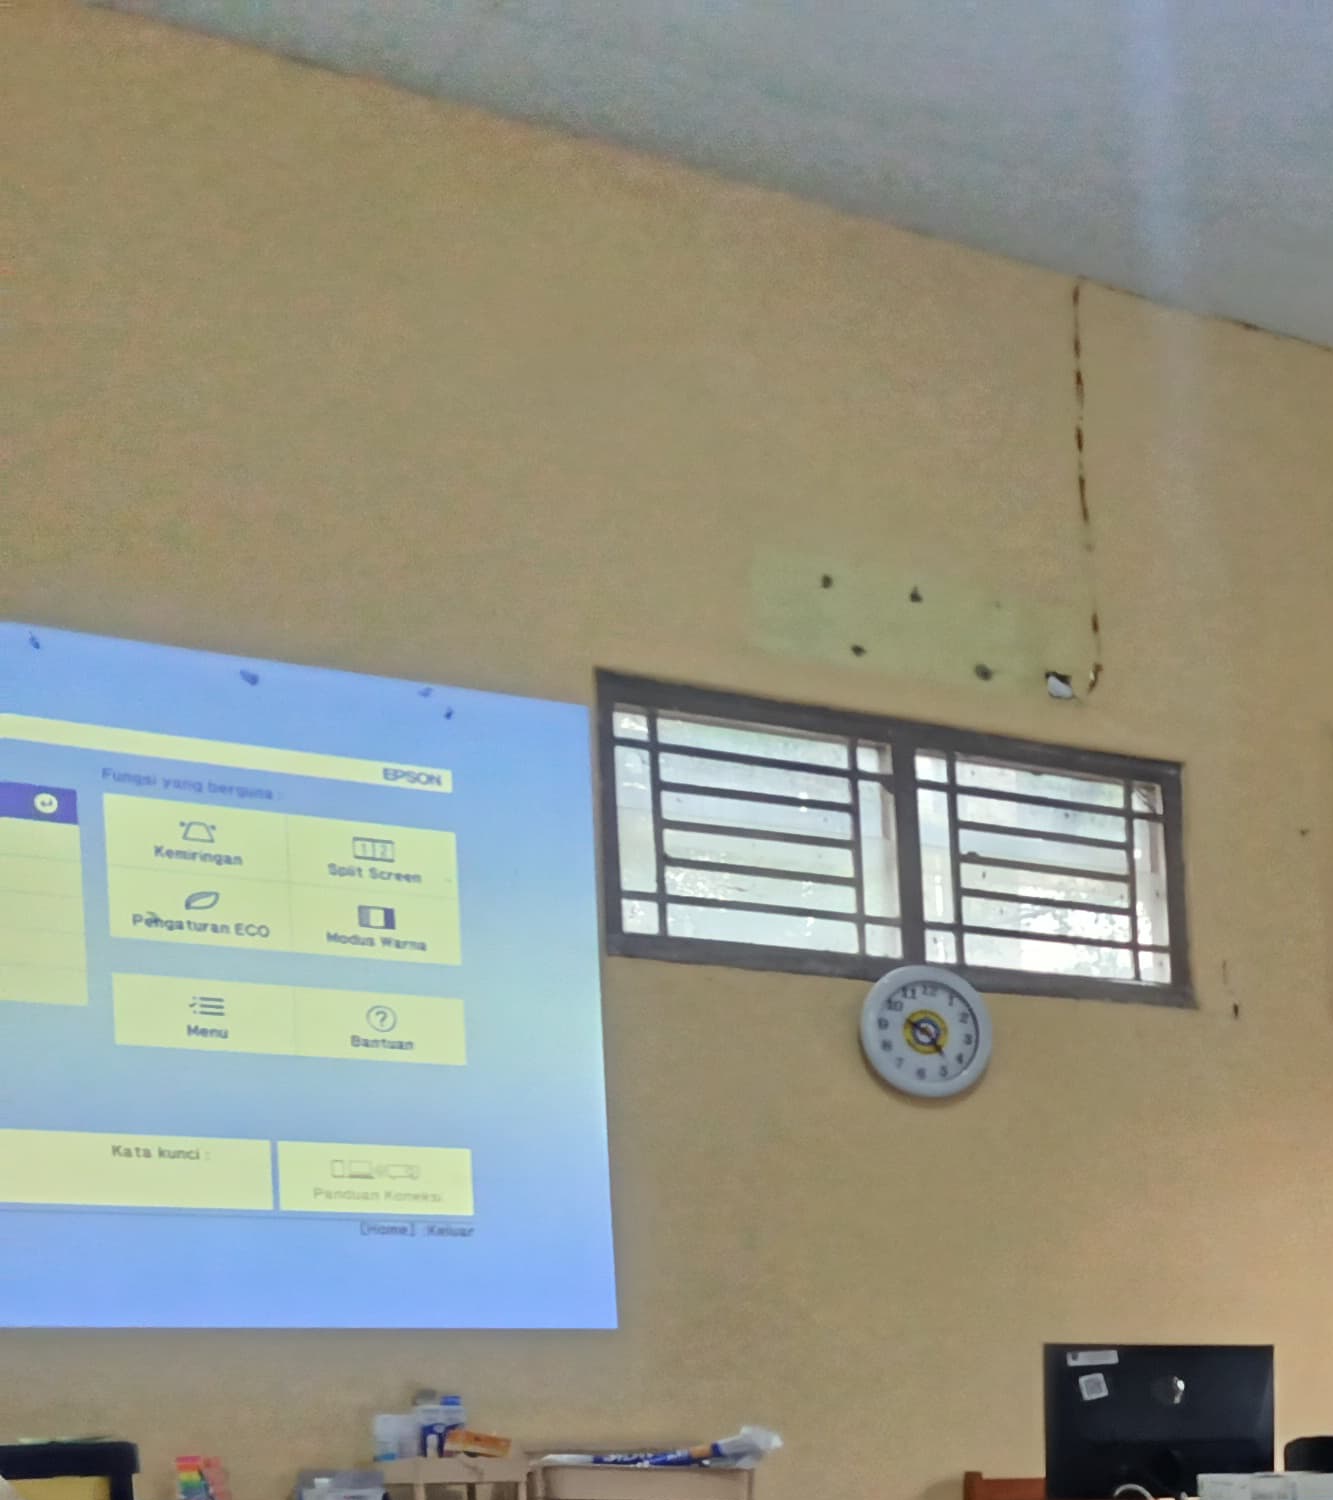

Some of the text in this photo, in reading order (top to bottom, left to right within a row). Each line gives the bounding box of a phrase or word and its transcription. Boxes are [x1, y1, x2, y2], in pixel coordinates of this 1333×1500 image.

[102, 767, 157, 786] Fungsi
[162, 777, 203, 793] yang
[207, 780, 273, 800] berguna
[383, 768, 442, 786] EPSON
[154, 845, 243, 866] Kemiringan
[328, 862, 422, 884] Split Screen
[132, 912, 270, 938] Pengaturan ECO
[326, 931, 427, 951] Modus Warna
[187, 1025, 229, 1039] Menu
[350, 1035, 414, 1050] Bantuan
[112, 1145, 152, 1159] Kata
[158, 1147, 200, 1160] kunci
[313, 1187, 442, 1202] Panduan Koneksi
